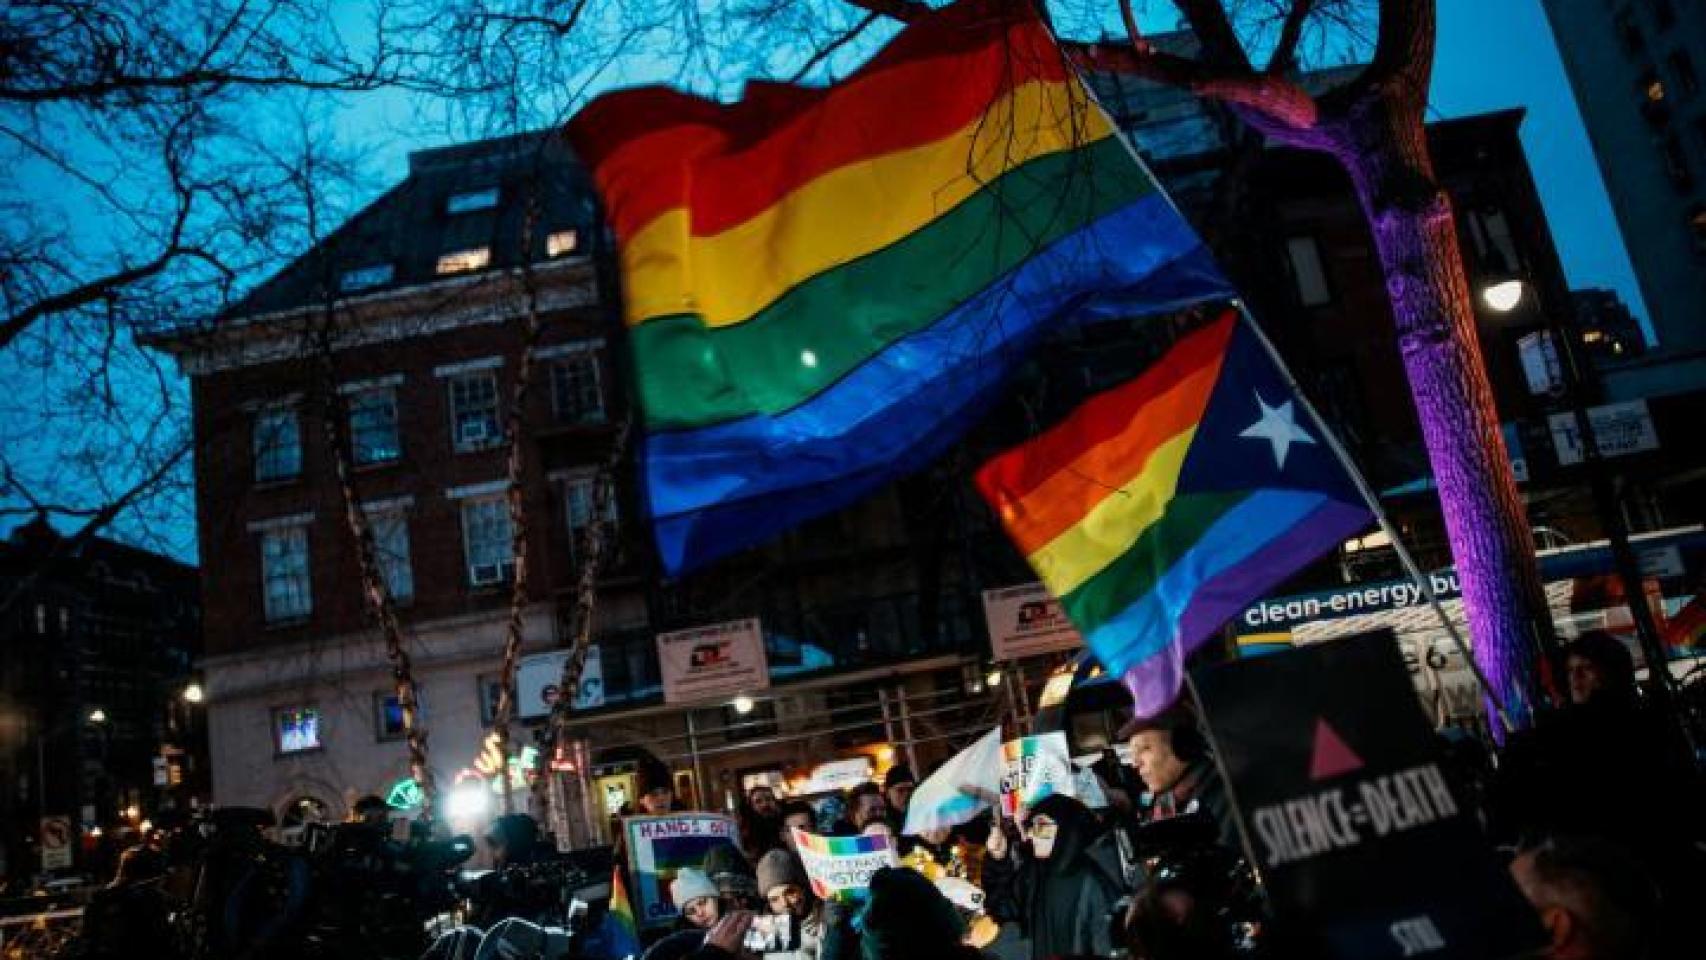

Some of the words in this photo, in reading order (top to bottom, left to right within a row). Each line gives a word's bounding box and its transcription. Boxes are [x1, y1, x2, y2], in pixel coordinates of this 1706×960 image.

[1245, 582, 1420, 627] clean-energy
[1430, 575, 1463, 596] bu
[1255, 764, 1457, 867] SILENCE=DEATH
